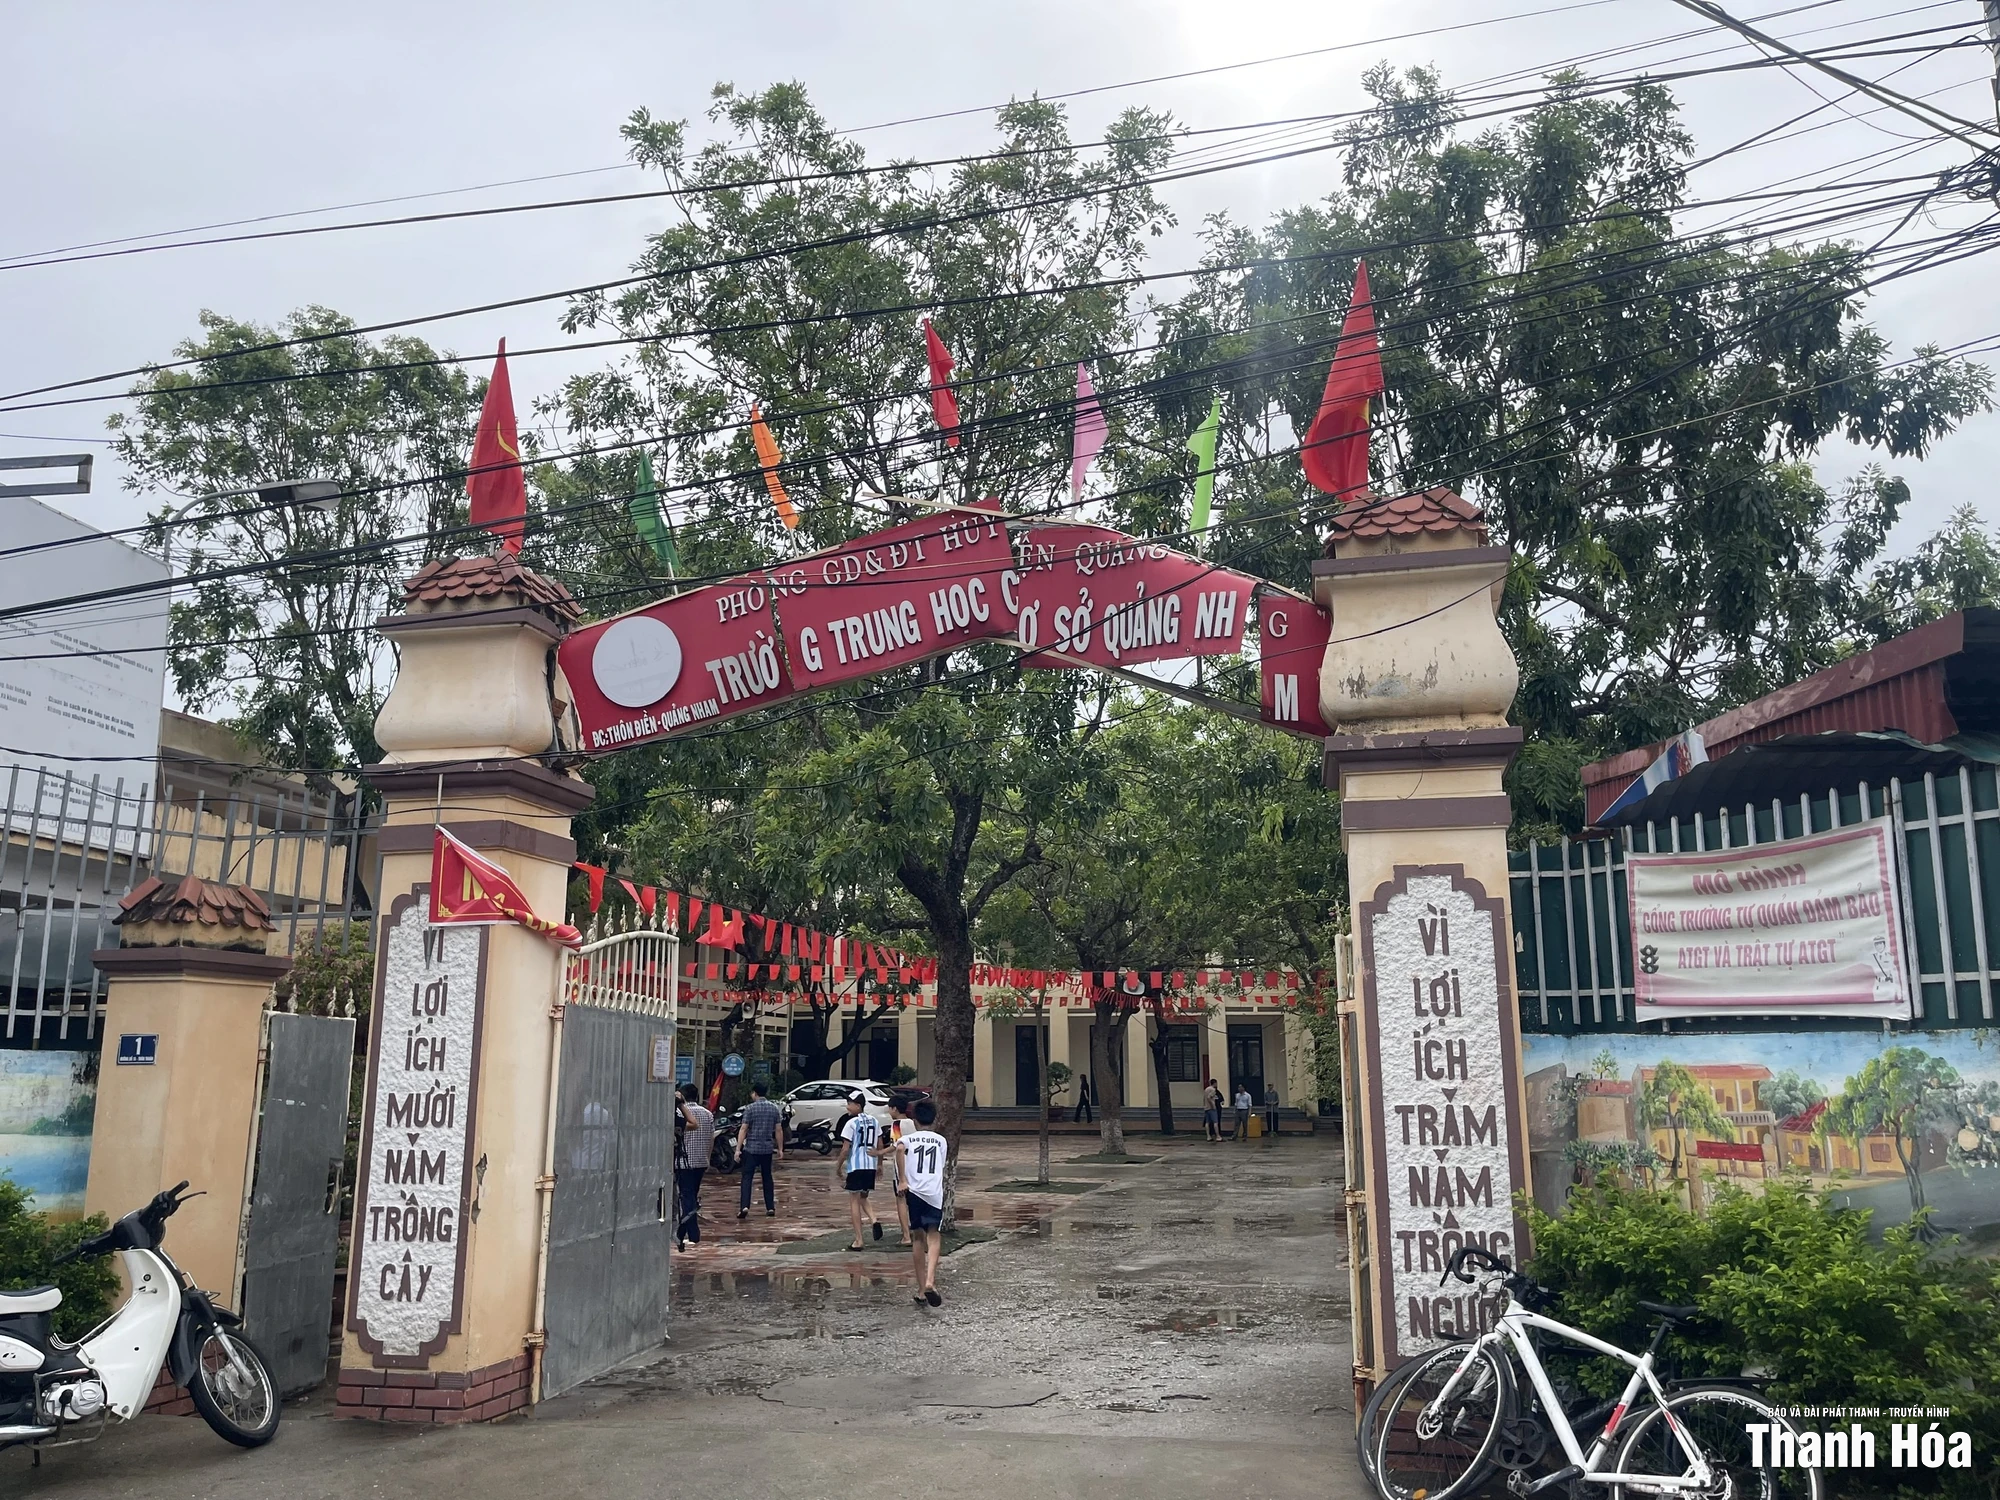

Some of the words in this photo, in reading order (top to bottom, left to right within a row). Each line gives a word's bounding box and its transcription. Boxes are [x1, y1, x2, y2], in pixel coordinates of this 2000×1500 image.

[716, 569, 808, 623] PHÒNG
[823, 534, 926, 585] GD&ĐT
[828, 600, 922, 664] TRUNG
[929, 577, 990, 635] HỌC
[1054, 587, 1094, 653] SỞ
[1103, 581, 1181, 660] QUẢNG
[661, 703, 691, 731] QUẢNG
[690, 698, 720, 721] NHAM
[1692, 869, 1734, 896] MÔ
[1737, 863, 1806, 892] HÌNH
[1418, 902, 1450, 956] VÌ
[1736, 903, 1757, 933] TỰ
[1757, 893, 1802, 929] QUẢN
[1803, 889, 1844, 923] ĐẢM
[1844, 882, 1881, 920] BẢO
[1678, 946, 1710, 969] ATGT
[1714, 940, 1731, 968] VÀ
[1736, 939, 1770, 972] TRẬT
[1775, 939, 1795, 971] TỰ
[412, 974, 449, 1025] LỢI
[1413, 968, 1462, 1027] LỢI
[135, 1037, 142, 1055] 1
[405, 1023, 447, 1072] ÍCH
[1413, 1022, 1468, 1081] ÍCH
[386, 1078, 456, 1129] MƯỜI
[1394, 1088, 1498, 1147] TRĂM
[384, 1132, 447, 1185] NĂM
[857, 1125, 876, 1147] 10
[913, 1144, 937, 1174] 11
[1408, 1149, 1493, 1208] NĂM
[370, 1189, 454, 1243] TRỒNG
[1396, 1209, 1512, 1273] TRỒNG
[379, 1248, 433, 1302] CÂY
[1408, 1282, 1506, 1338] NGƯỜ
